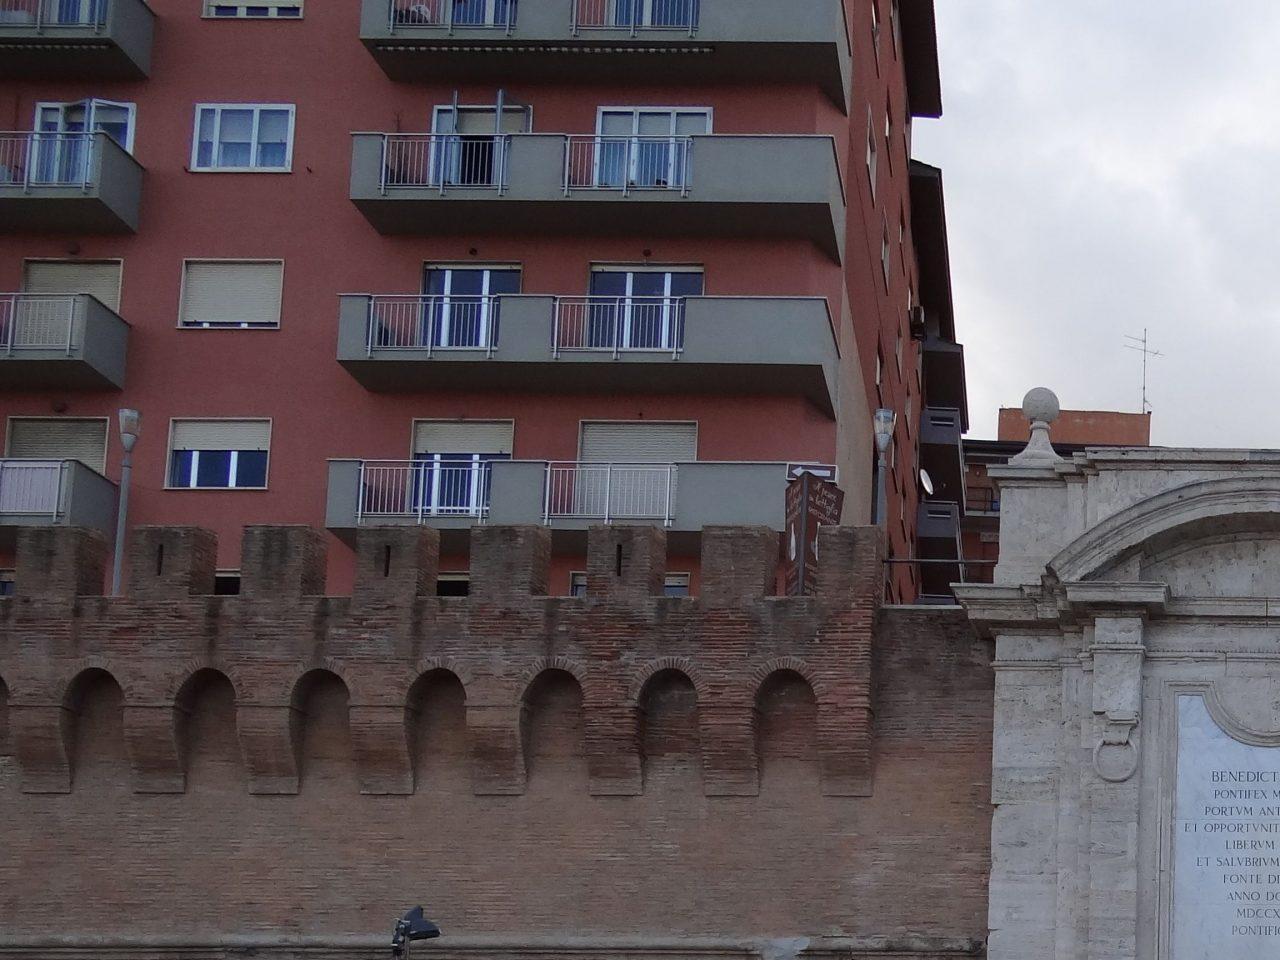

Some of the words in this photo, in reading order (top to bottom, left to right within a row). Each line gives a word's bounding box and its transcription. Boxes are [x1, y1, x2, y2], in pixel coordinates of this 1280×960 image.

[1214, 789, 1268, 800] PONTIFEX
[1204, 806, 1253, 817] PORTVM
[1225, 839, 1275, 851] LIBERVM
[1196, 856, 1211, 867] ET
[1216, 856, 1280, 867] SALVBRIVM
[1223, 873, 1263, 884] FONTE
[1227, 891, 1261, 902] ANNO
